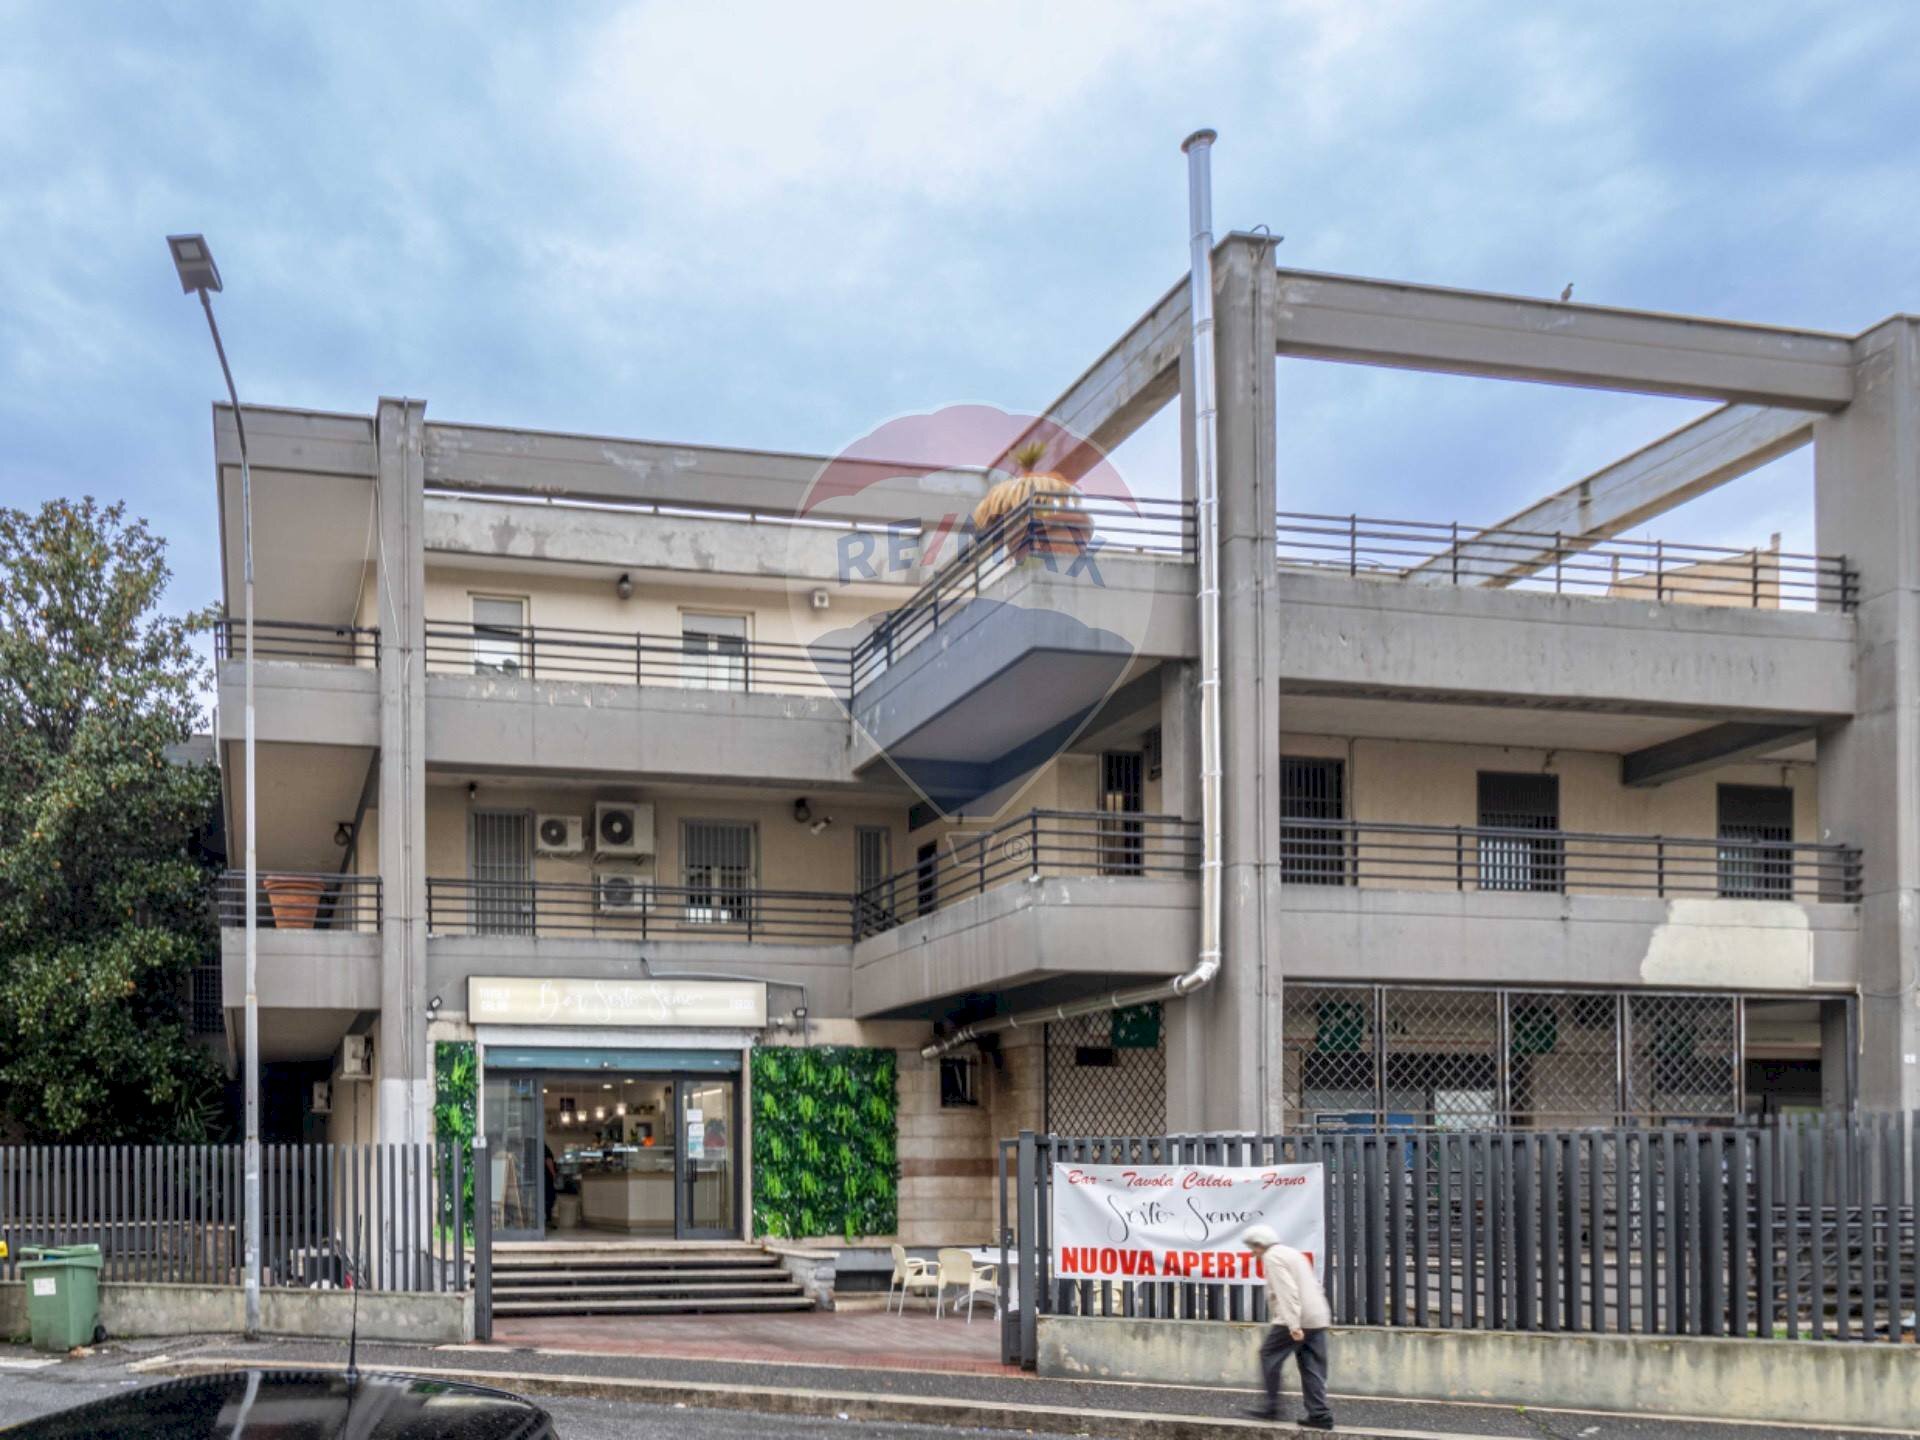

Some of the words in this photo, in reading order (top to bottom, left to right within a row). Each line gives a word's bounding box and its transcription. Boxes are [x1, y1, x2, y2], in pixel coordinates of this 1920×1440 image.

[1068, 1169, 1097, 1185] Bar
[1122, 1171, 1174, 1188] Tavola
[1182, 1171, 1233, 1190] Calda
[1261, 1172, 1306, 1190] Forno
[1061, 1247, 1156, 1275] NUOVA
[1162, 1251, 1314, 1279] APERT
